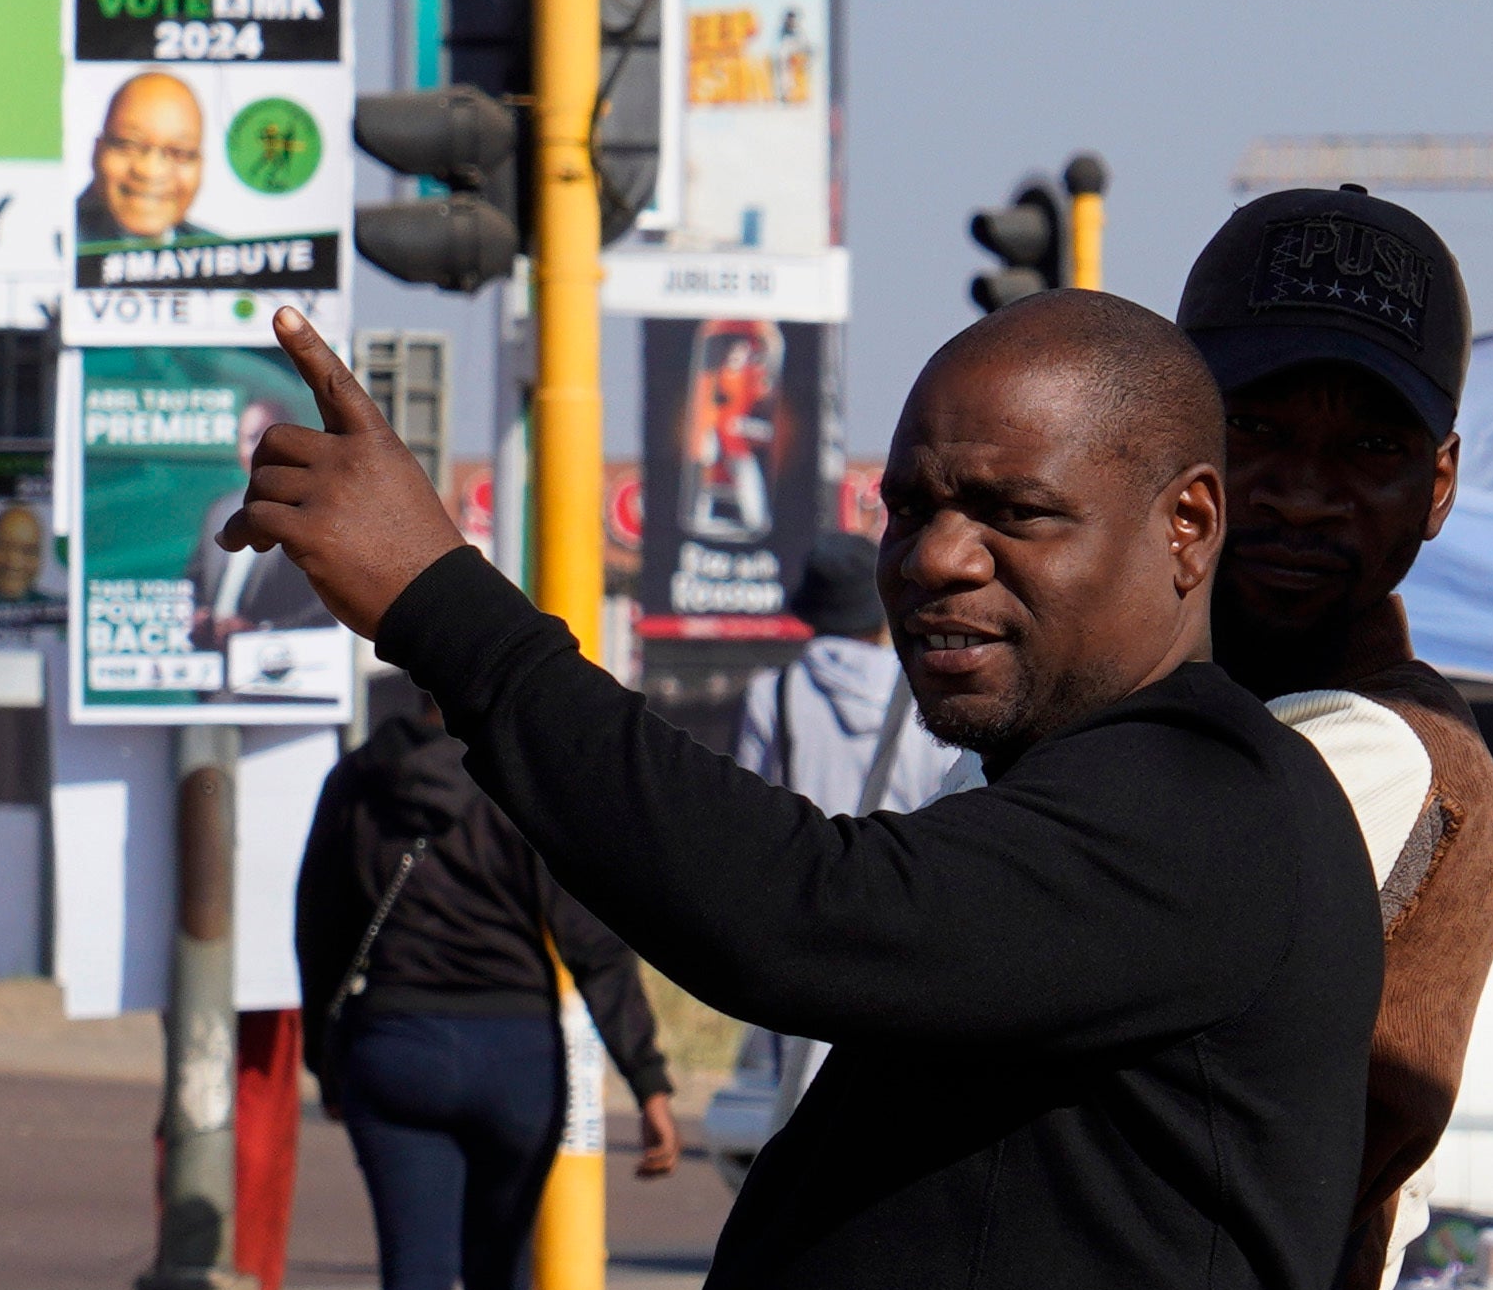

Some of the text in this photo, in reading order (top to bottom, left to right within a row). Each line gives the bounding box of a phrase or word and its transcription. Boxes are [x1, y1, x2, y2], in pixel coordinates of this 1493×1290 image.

[153, 21, 264, 60] 2024
[100, 238, 315, 285] #MAYIBUYE
[1299, 217, 1434, 309] PUSH
[87, 293, 190, 324] VOTE
[86, 412, 237, 446] PREMIER
[89, 597, 194, 625] POWER
[89, 623, 193, 653] BACK
